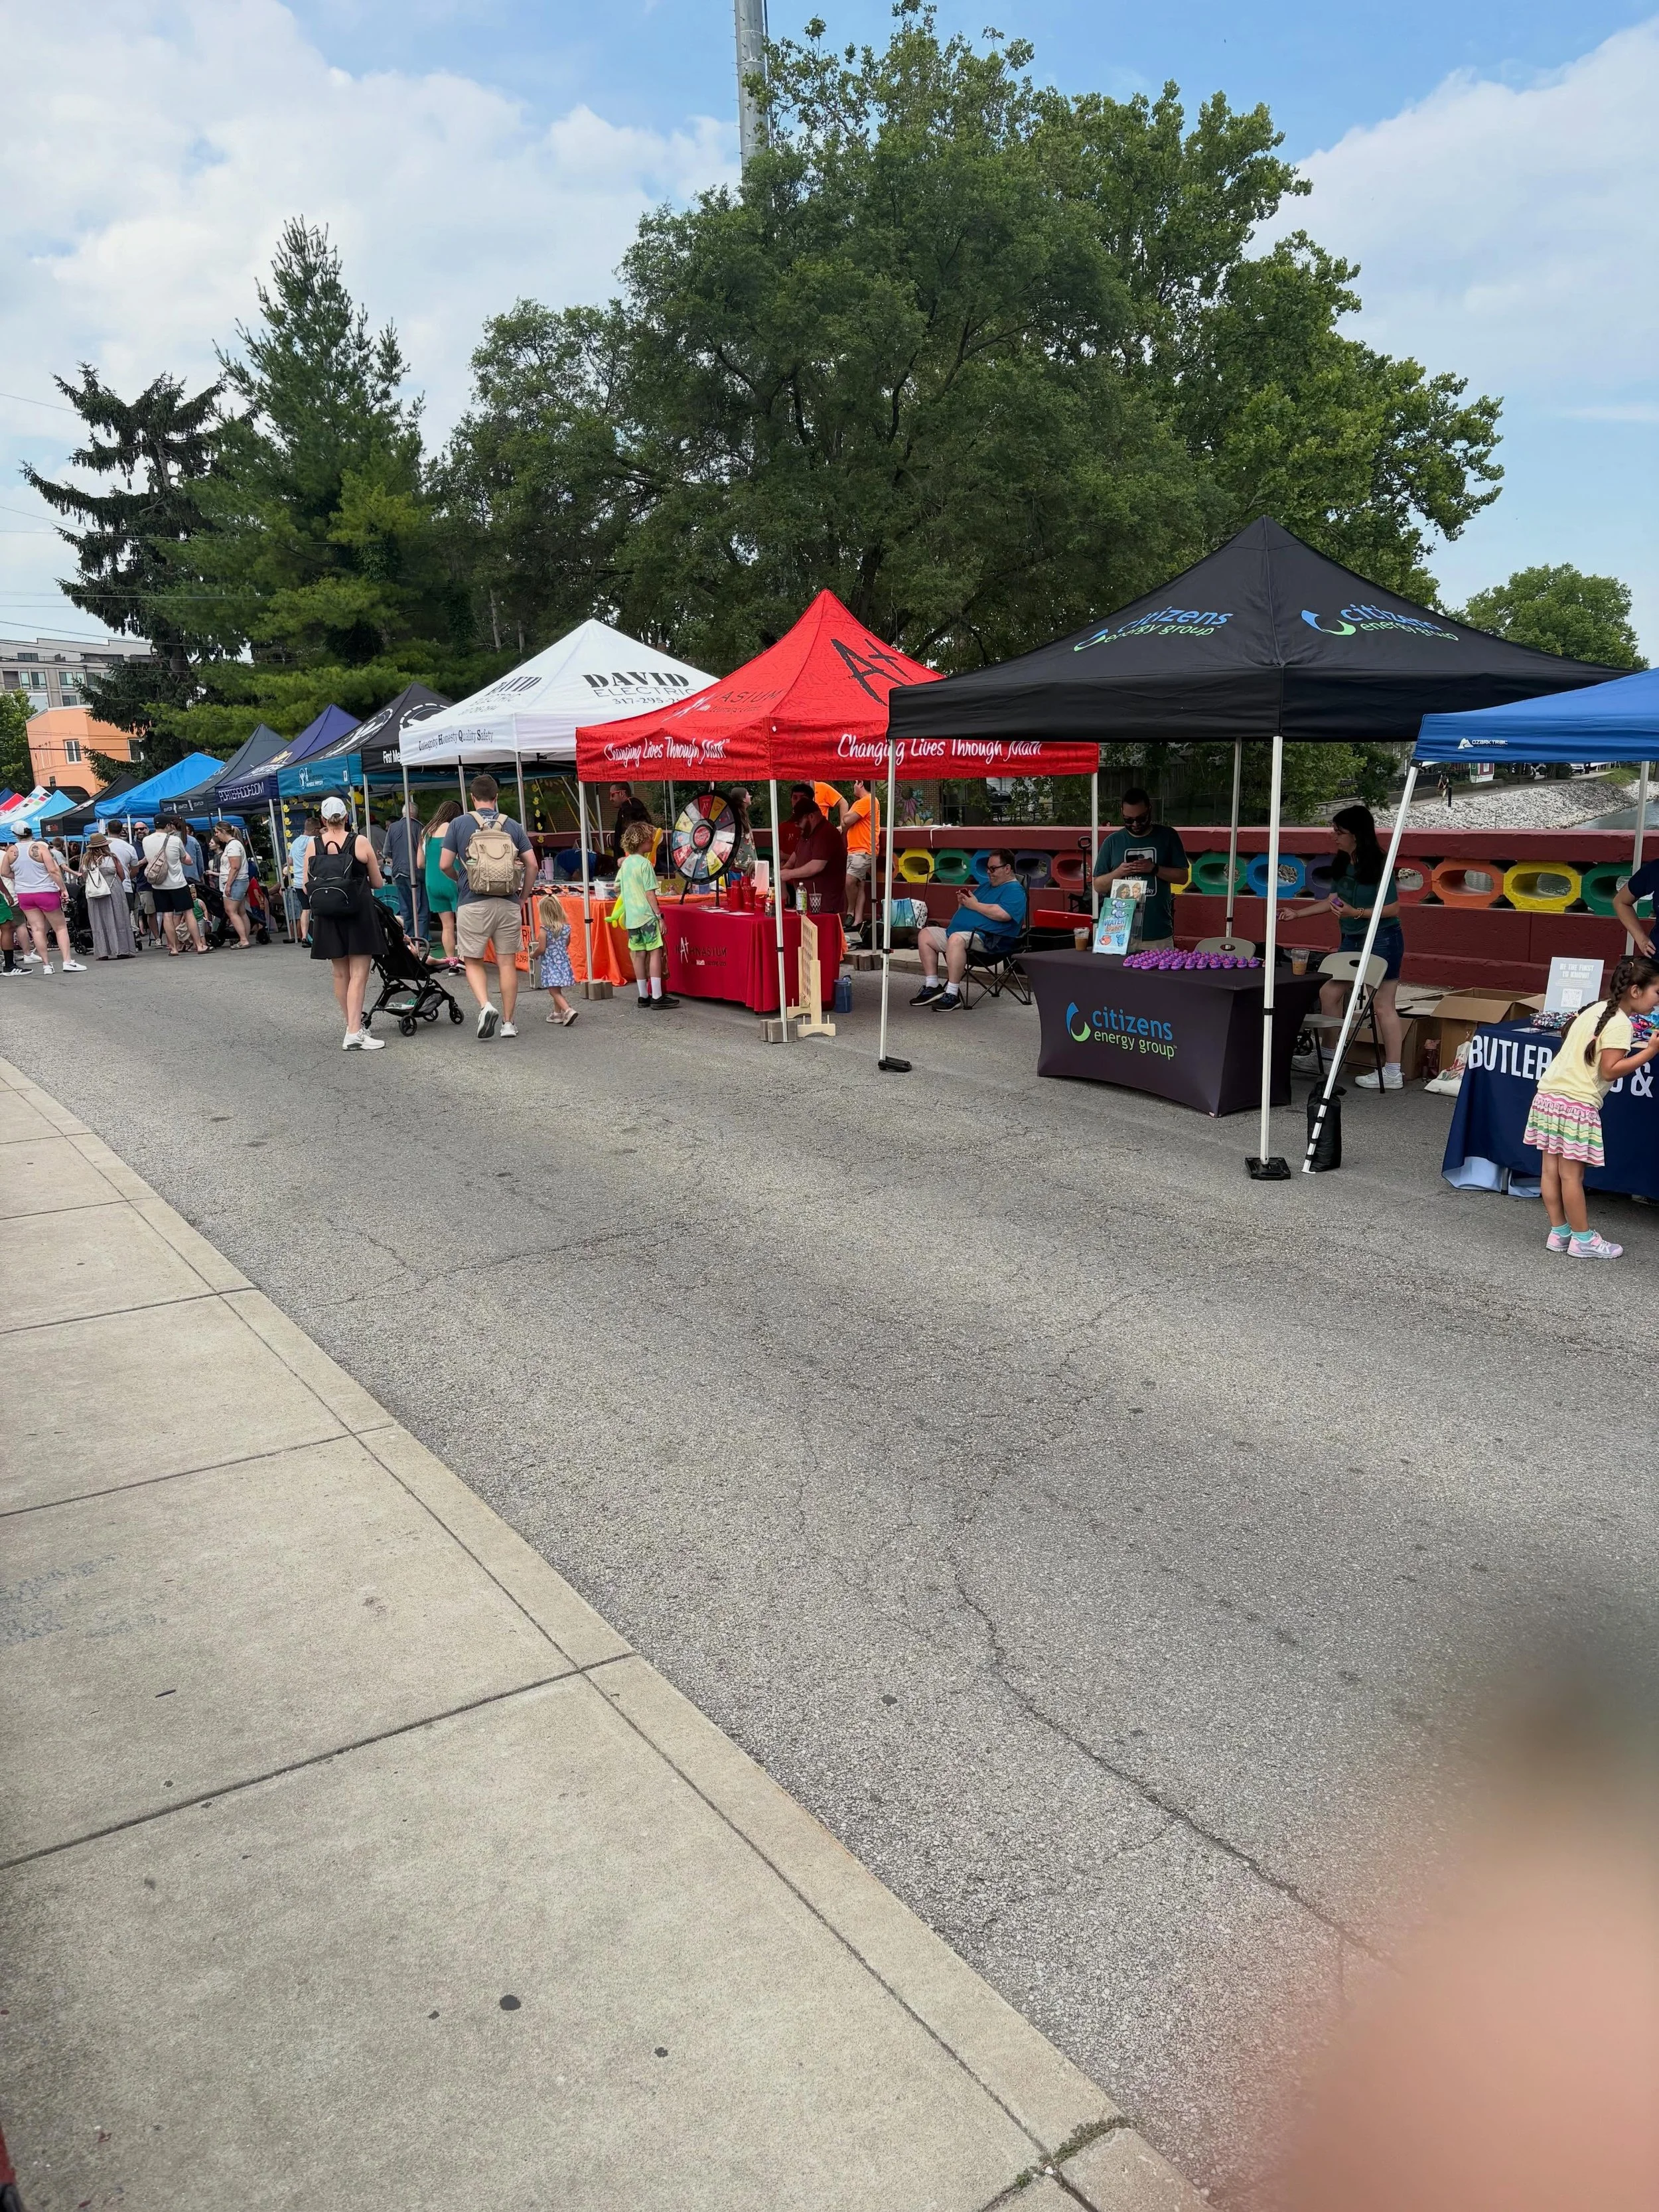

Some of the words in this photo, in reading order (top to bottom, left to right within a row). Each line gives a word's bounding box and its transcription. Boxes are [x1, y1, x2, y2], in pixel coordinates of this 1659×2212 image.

[1118, 606, 1234, 634] citizens
[1340, 603, 1443, 631] citizens
[1360, 620, 1417, 634] energy
[1415, 627, 1459, 642] group
[1104, 623, 1162, 643] energy
[1159, 625, 1214, 636] group
[581, 672, 689, 688] DAVID
[593, 686, 697, 698] ELECTRIC
[419, 740, 439, 751] Integrity
[438, 734, 458, 745] Honesty
[459, 730, 477, 743] Quality
[477, 729, 494, 743] Safety
[604, 743, 642, 768] Changing
[643, 737, 664, 759] Lives
[664, 737, 699, 767] Through
[837, 733, 905, 766] Changig
[910, 739, 946, 757] Lives
[382, 751, 392, 764] First
[1092, 1006, 1173, 1041] citizens
[1094, 1031, 1135, 1050] energy
[1139, 1039, 1175, 1061] group
[1630, 1061, 1654, 1098] &
